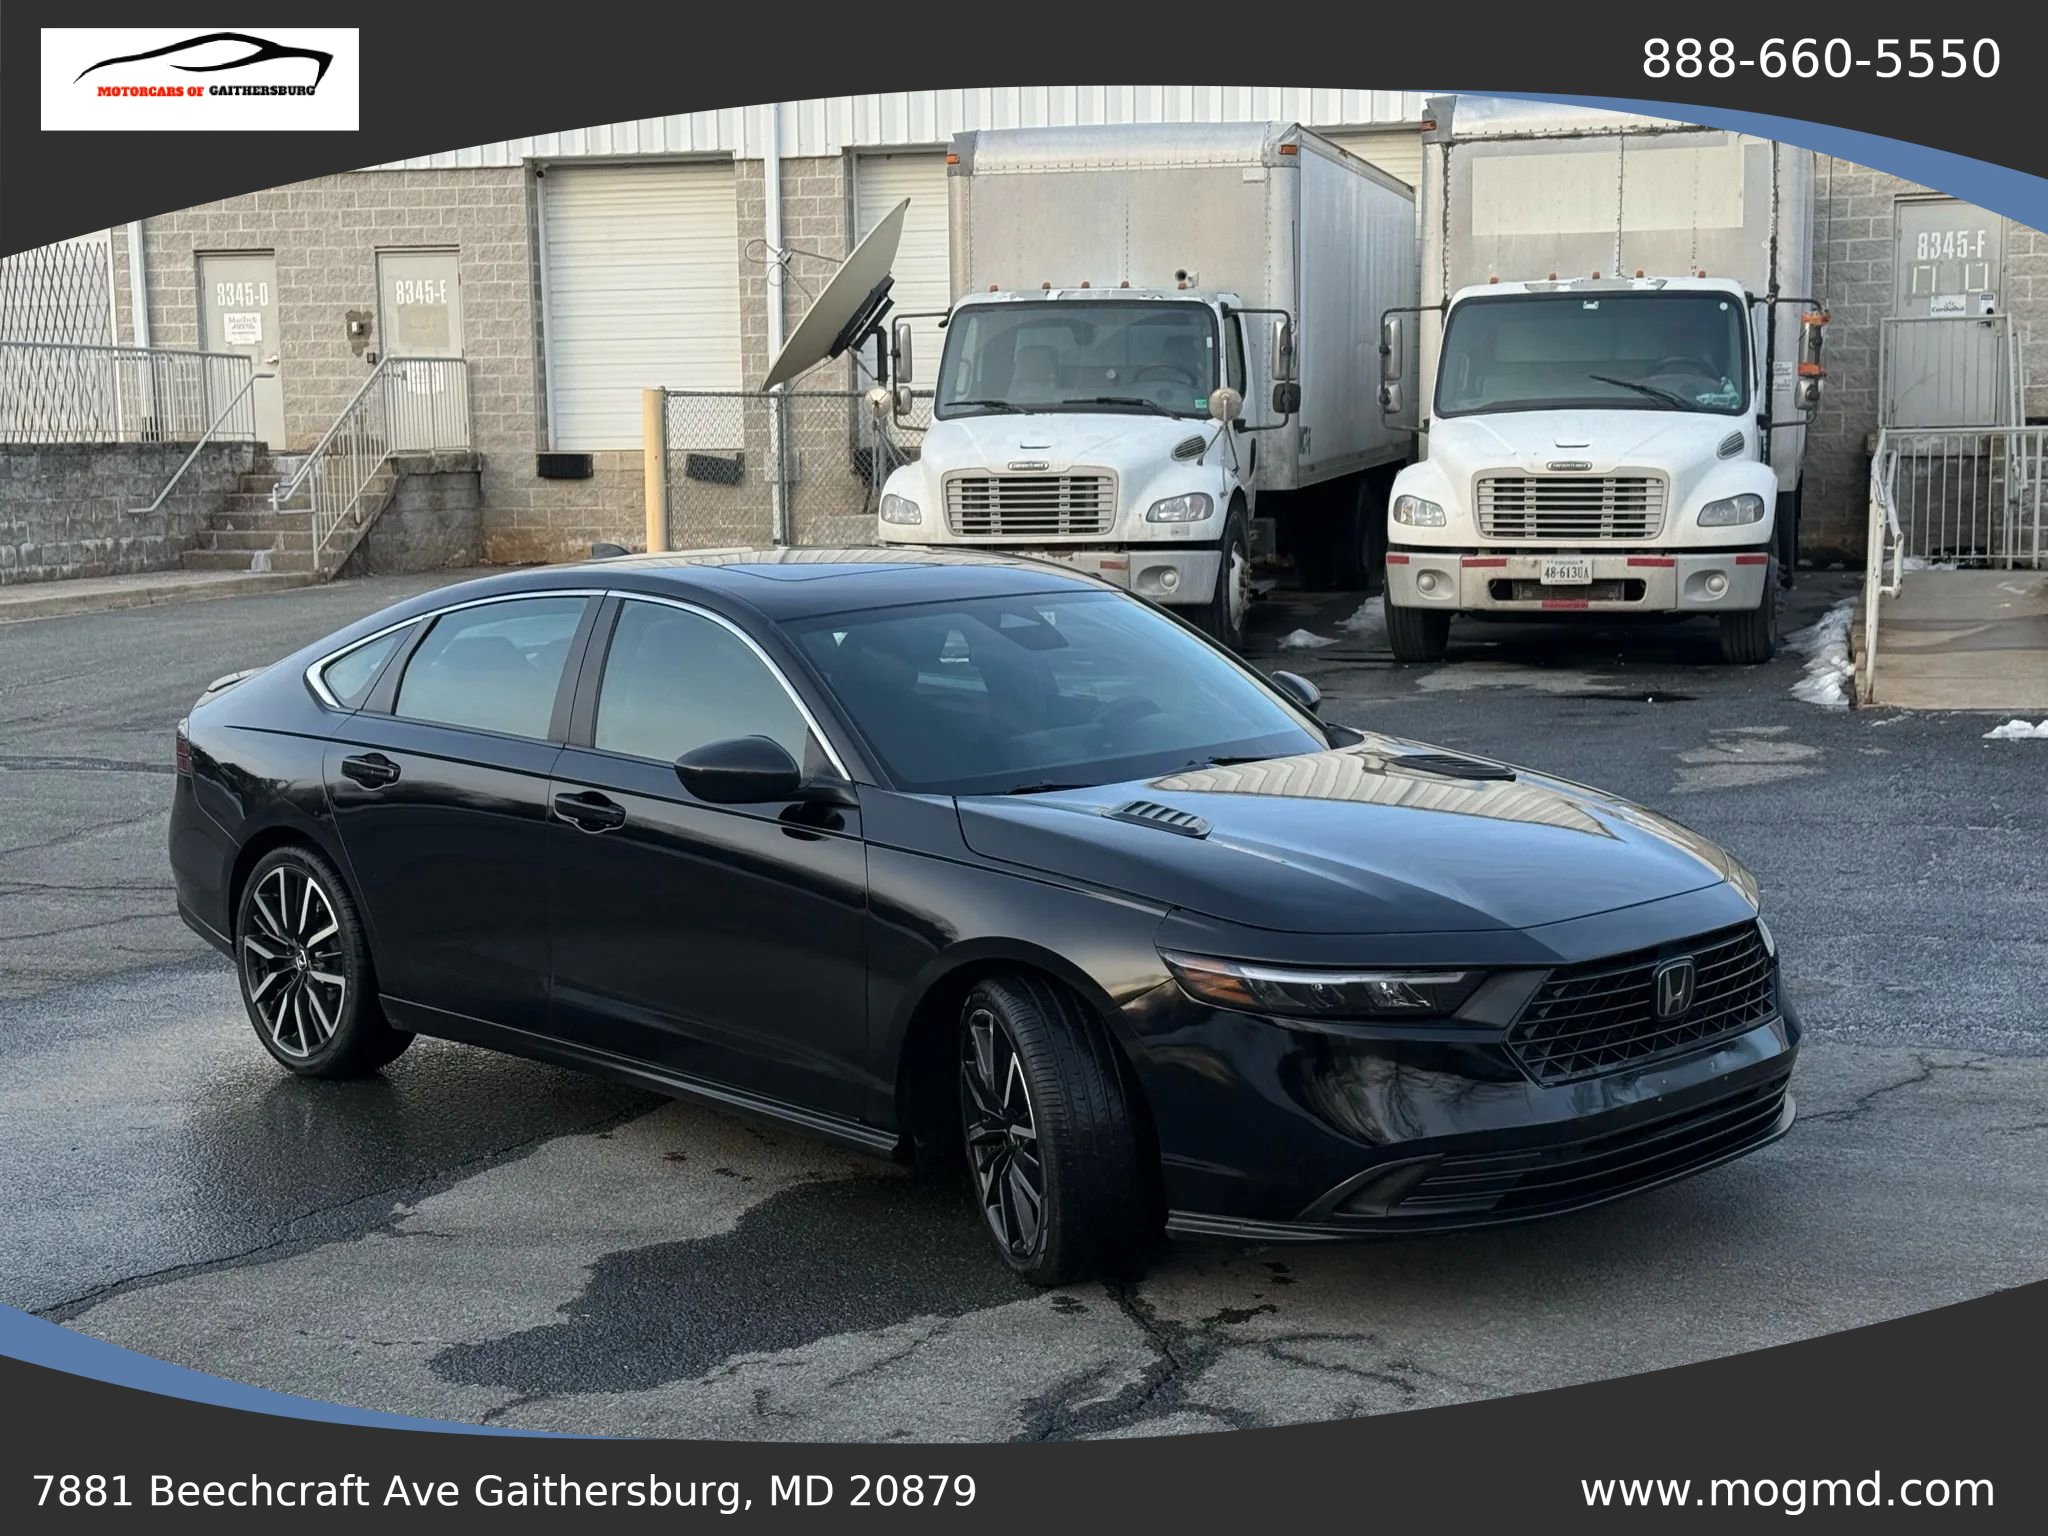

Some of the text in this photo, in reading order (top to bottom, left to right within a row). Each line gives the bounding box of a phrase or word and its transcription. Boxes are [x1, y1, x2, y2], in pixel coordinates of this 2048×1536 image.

[1917, 229, 1986, 260] 8345-F
[217, 282, 269, 307] 8345-D
[396, 280, 447, 305] 8345-E
